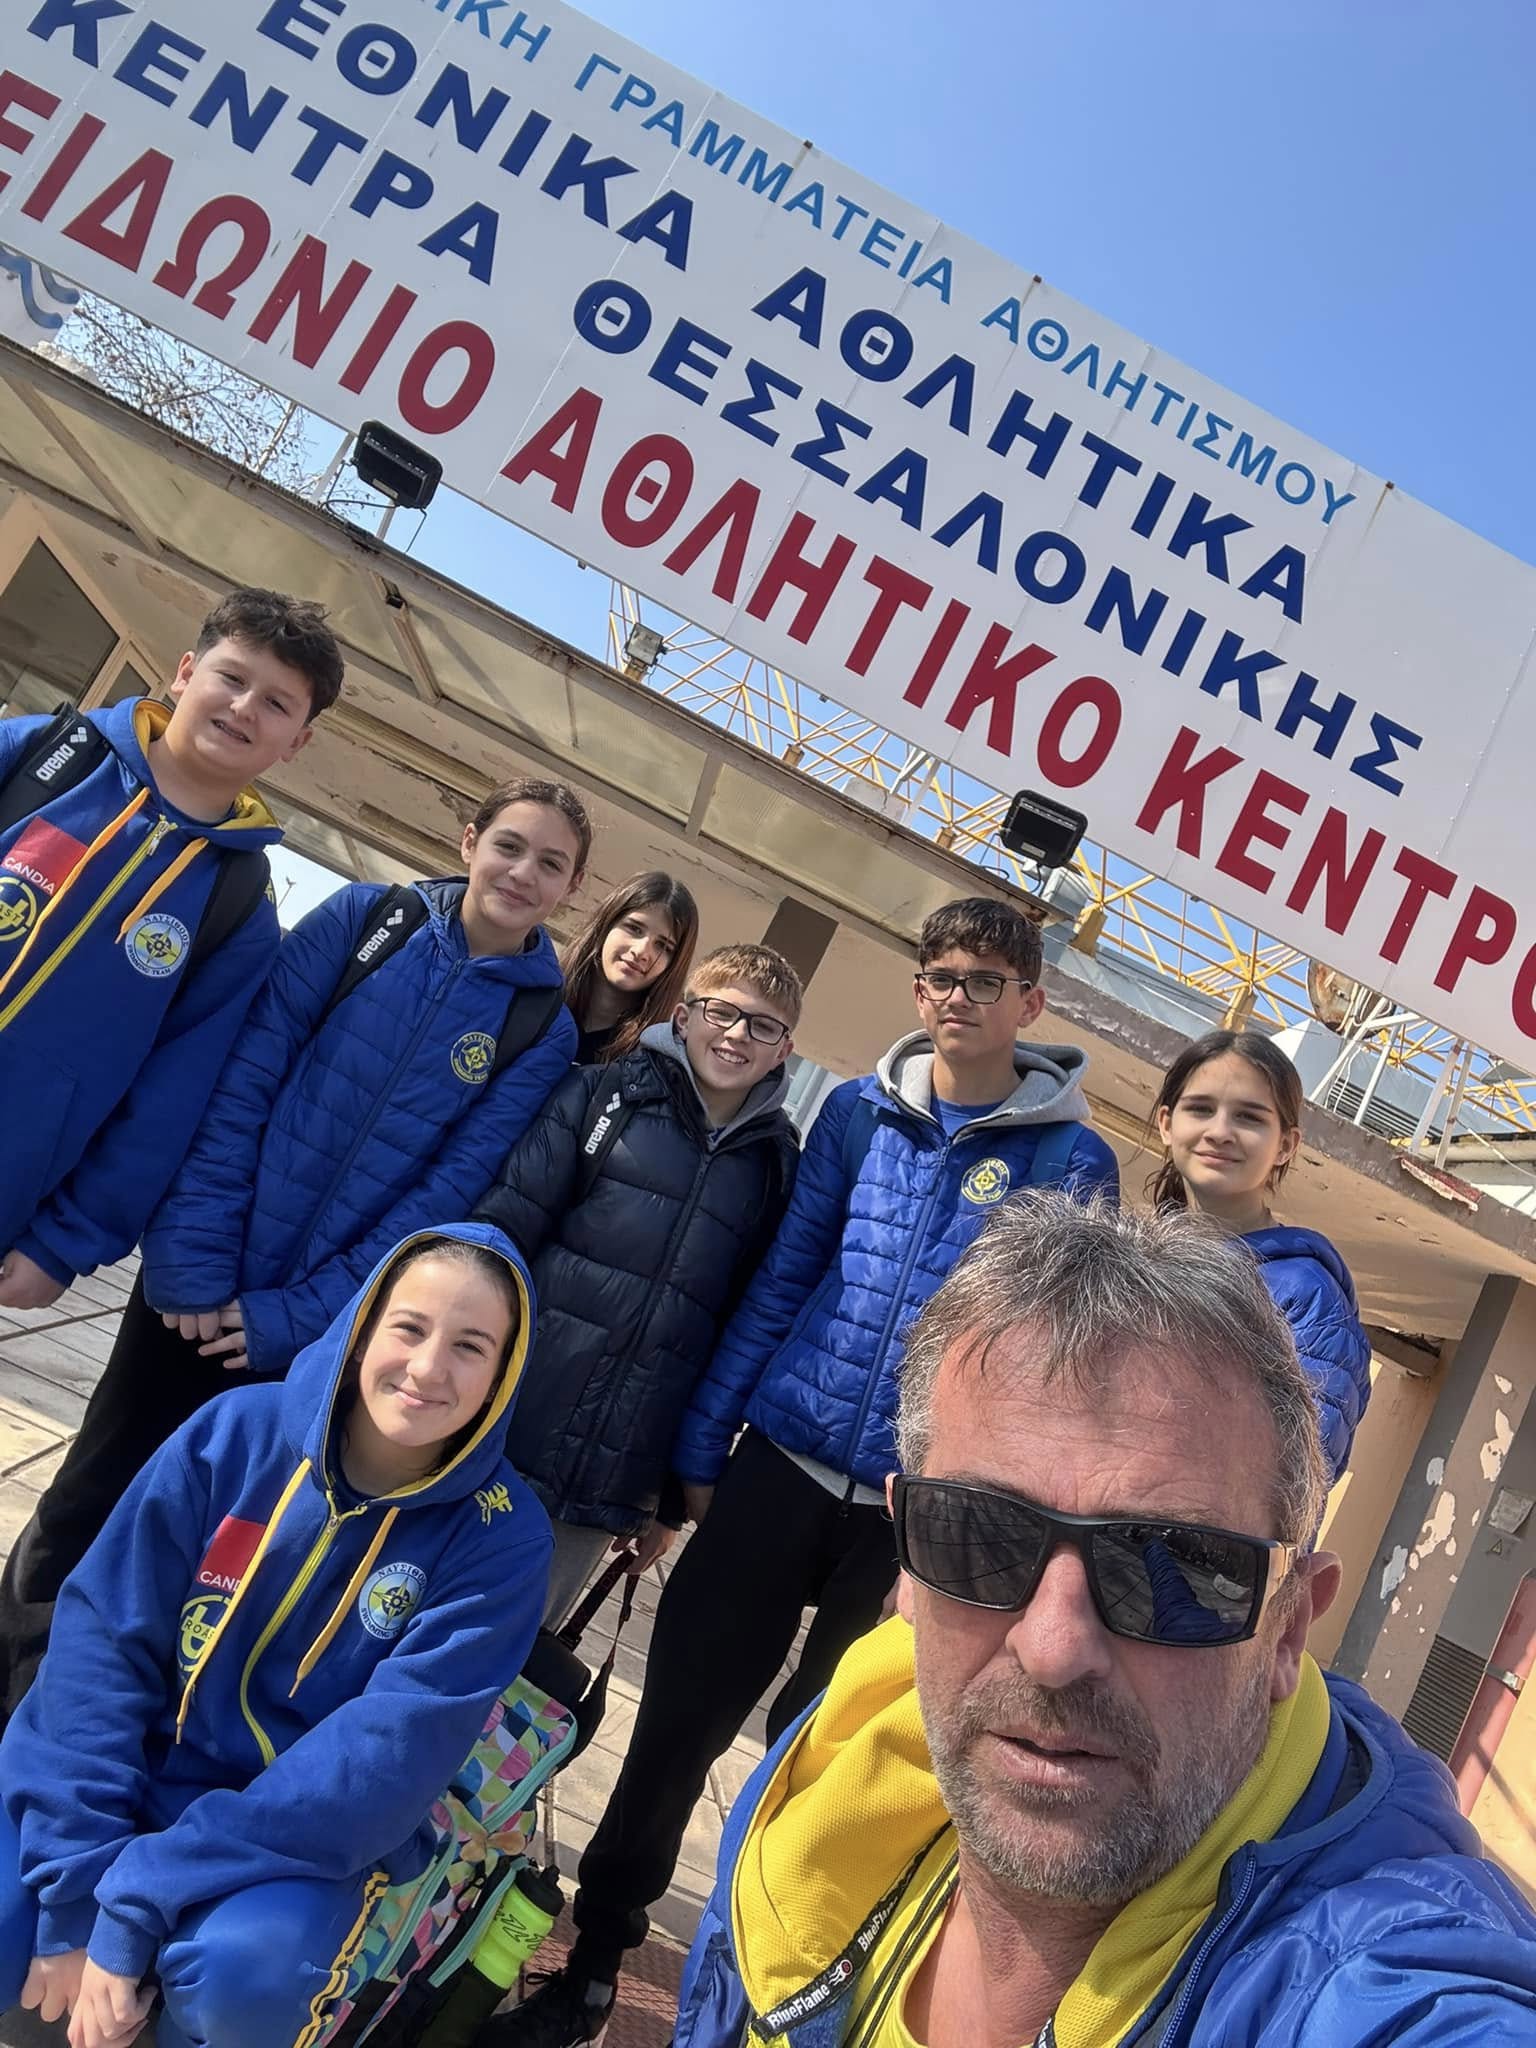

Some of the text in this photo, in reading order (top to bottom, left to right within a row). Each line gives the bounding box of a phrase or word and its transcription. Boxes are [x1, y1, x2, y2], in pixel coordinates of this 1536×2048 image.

[434, 0, 1357, 525] ΚΗ ΓΡΑΜΜΑΤΕΙΑ ΑΘΛΗΤΙΣΜΟΥ
[256, 0, 1306, 624] ΕΘΝΙΚΑ ΑΘΛΗΤΙΚΑ
[26, 0, 1423, 797] ΚΕΝΤΡΑ ΘΕΣΣΑΛΟΝΙΚΗΣ
[500, 388, 1123, 789] ΑΘΛΗΤΙΚΟ
[1135, 726, 1536, 1042] ΚΕΝΤΡ
[35, 742, 75, 782] arena
[4, 857, 55, 895] CANDIA
[357, 926, 391, 962] arena
[584, 1114, 612, 1155] arena
[766, 1983, 831, 2030] BlueFlame
